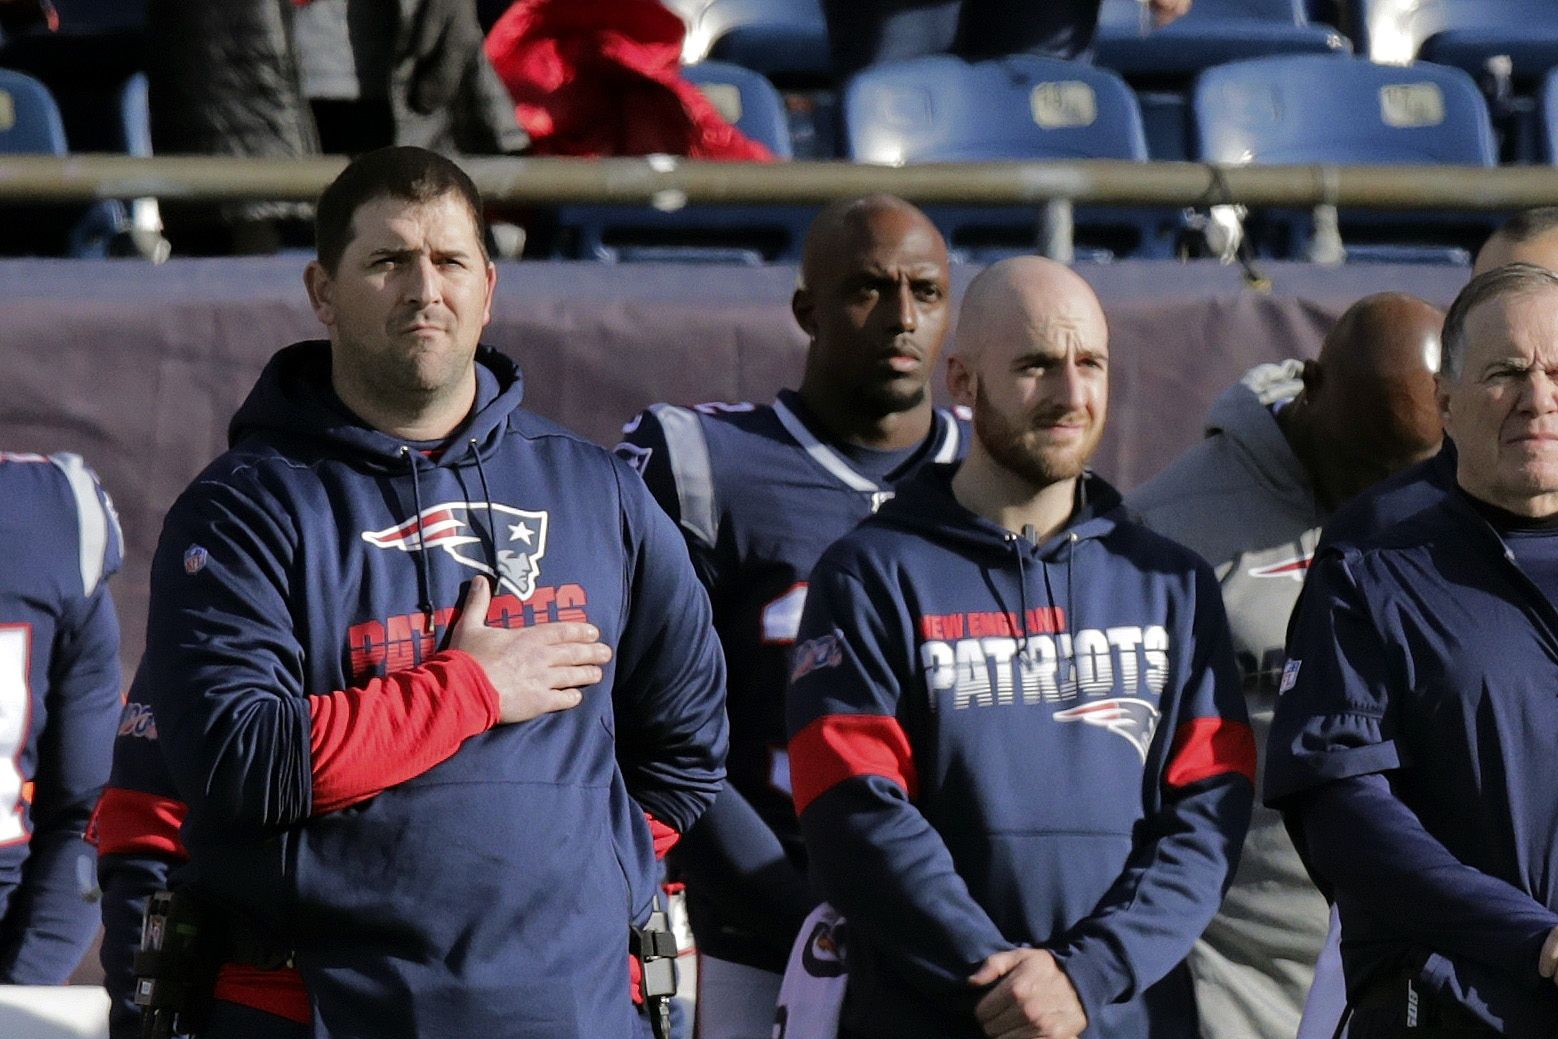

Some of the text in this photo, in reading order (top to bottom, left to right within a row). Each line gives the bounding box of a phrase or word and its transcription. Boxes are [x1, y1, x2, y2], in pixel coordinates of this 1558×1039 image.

[921, 605, 1066, 641] NEW ENGLAND
[920, 625, 1170, 712] PATRIOTS
